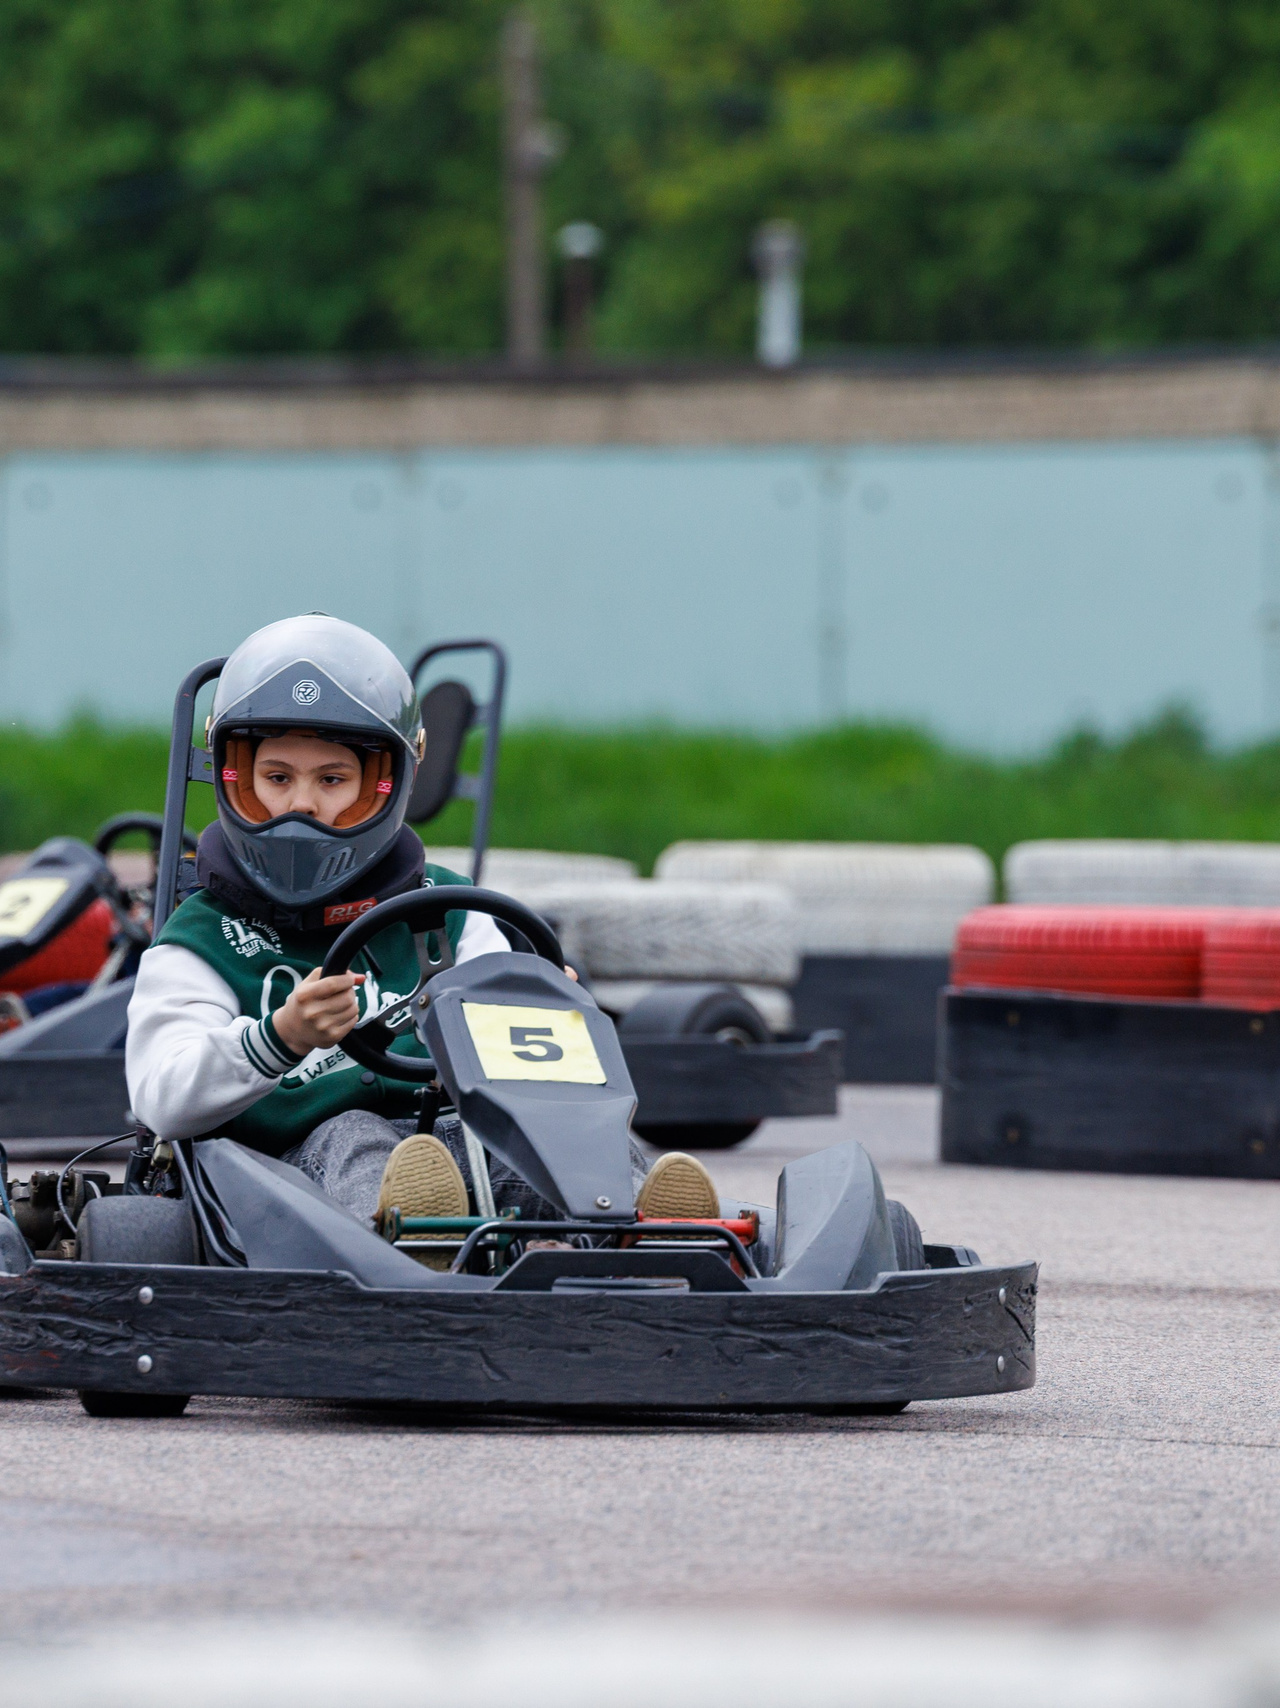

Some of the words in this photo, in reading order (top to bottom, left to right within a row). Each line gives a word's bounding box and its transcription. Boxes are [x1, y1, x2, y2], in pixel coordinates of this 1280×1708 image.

[329, 901, 373, 918] RLG
[510, 1026, 564, 1062] 5
[303, 1050, 347, 1081] WES
